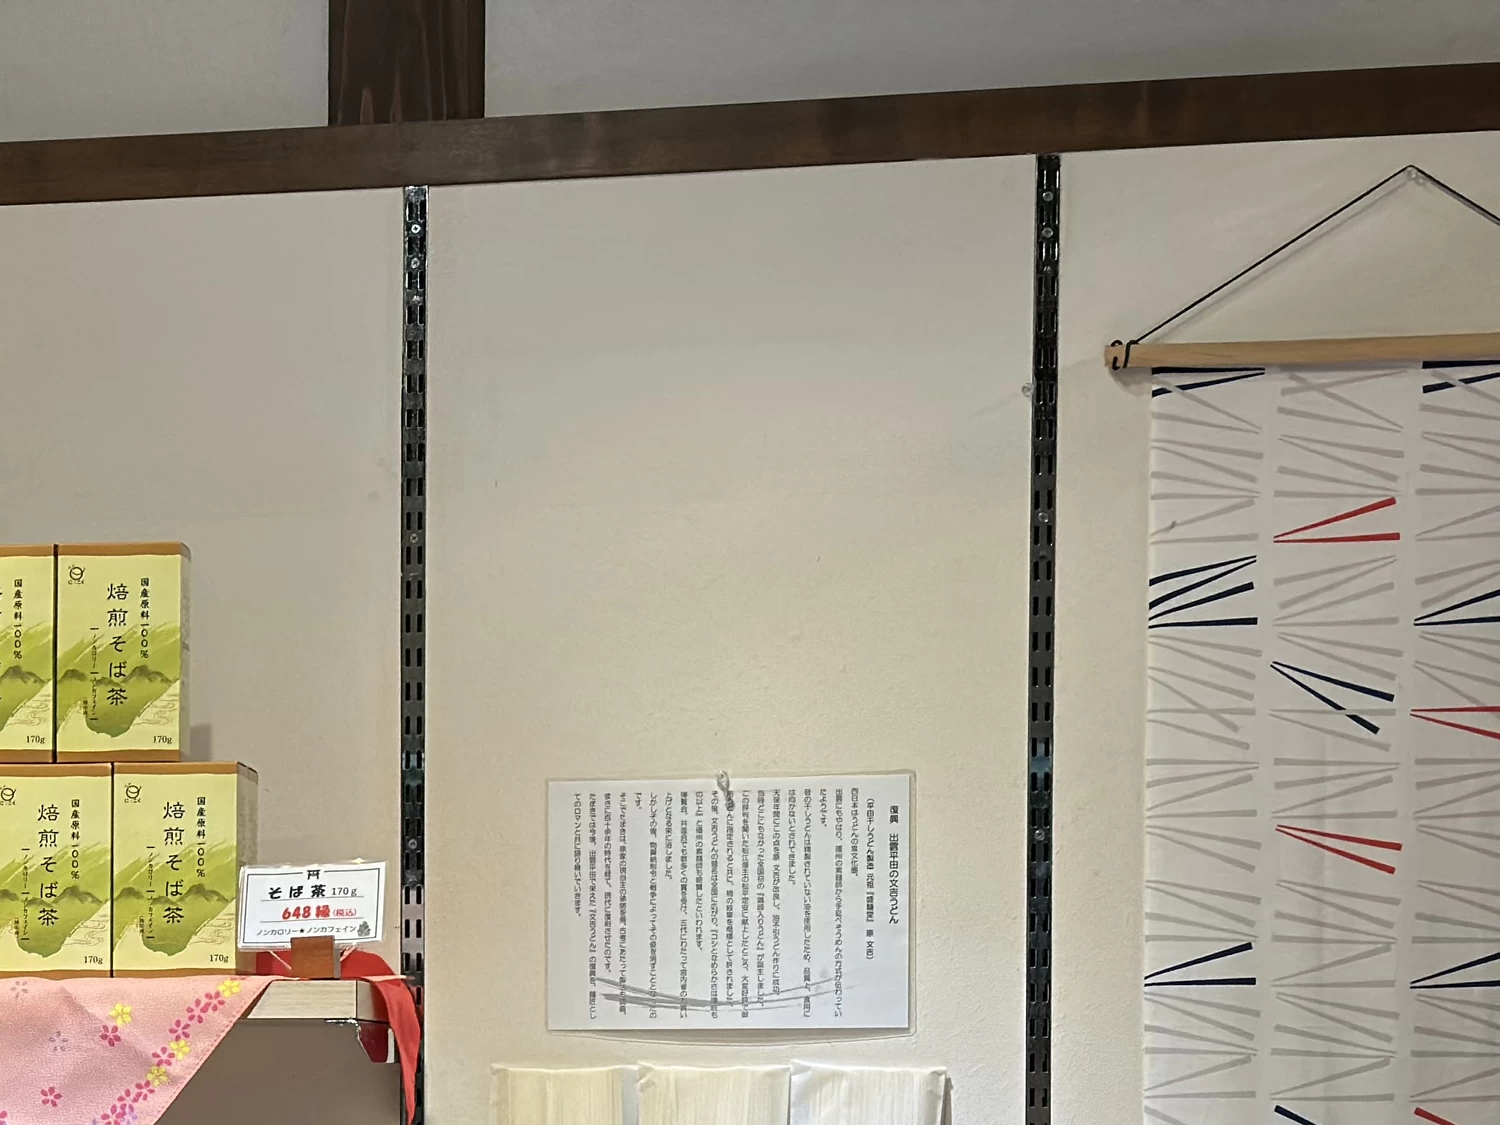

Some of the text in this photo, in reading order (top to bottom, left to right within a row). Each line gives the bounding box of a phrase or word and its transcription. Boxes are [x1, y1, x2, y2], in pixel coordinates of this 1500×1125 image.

[107, 583, 129, 706] 焙煎そば茶
[26, 735, 45, 745] 170g
[153, 735, 173, 745] 170g
[38, 804, 60, 926] 焙煎そば茶
[163, 801, 186, 924] 焙煎そば茶
[268, 884, 326, 900] そば茶
[282, 905, 311, 920] 648
[84, 955, 104, 965] 170g
[209, 954, 229, 963] 170g
